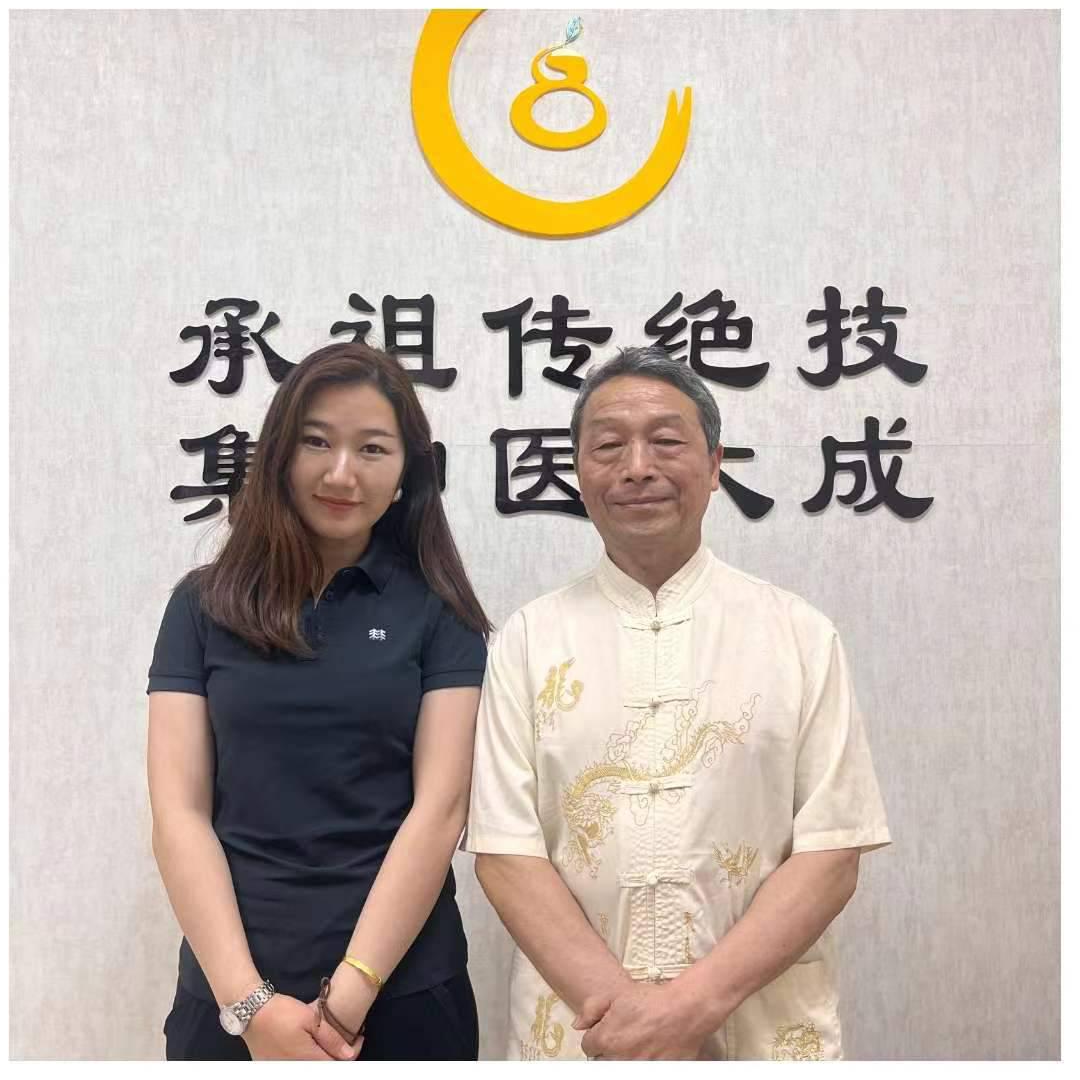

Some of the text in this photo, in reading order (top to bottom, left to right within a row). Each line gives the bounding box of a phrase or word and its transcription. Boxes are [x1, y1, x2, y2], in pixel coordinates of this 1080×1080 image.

[169, 285, 929, 398] 承祖传绝技
